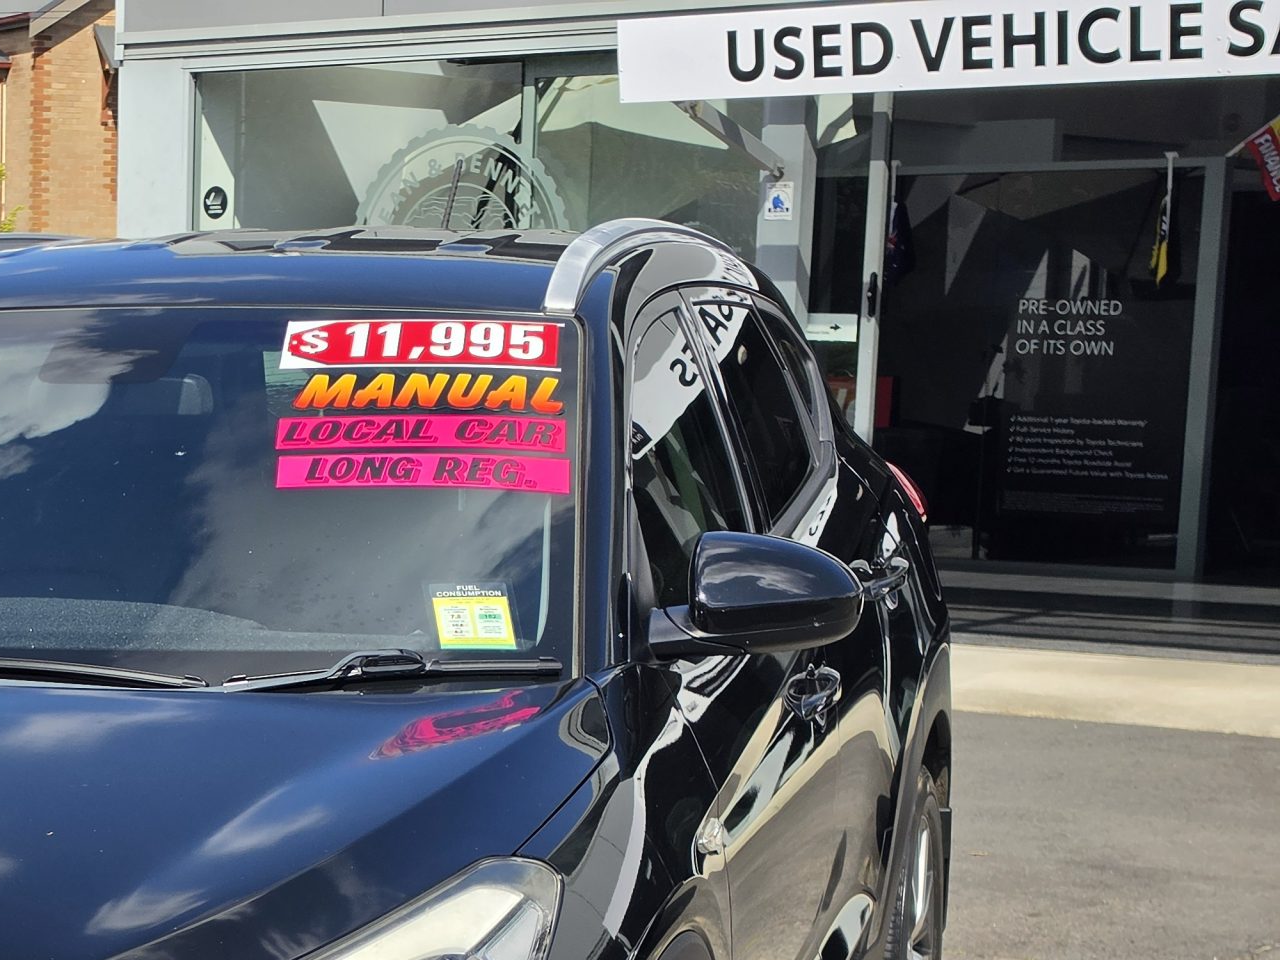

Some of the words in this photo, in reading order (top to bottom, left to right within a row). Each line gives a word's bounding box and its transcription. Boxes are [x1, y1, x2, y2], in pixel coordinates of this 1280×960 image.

[725, 21, 894, 83] USED
[910, 3, 1204, 73] VEHICLE
[1226, 0, 1280, 58] S
[1018, 299, 1123, 316] PRE-OWNED
[1017, 319, 1034, 335] IN
[1038, 319, 1050, 334] A
[1053, 319, 1106, 336] CLASS
[1015, 339, 1040, 355] OF
[1042, 340, 1066, 356] ITS
[1069, 340, 1114, 356] OWN
[291, 373, 564, 414] MANUAL
[281, 418, 438, 445] LOCAL
[454, 418, 561, 446] CAR
[304, 456, 423, 485] LONG
[432, 457, 538, 489] REG.
